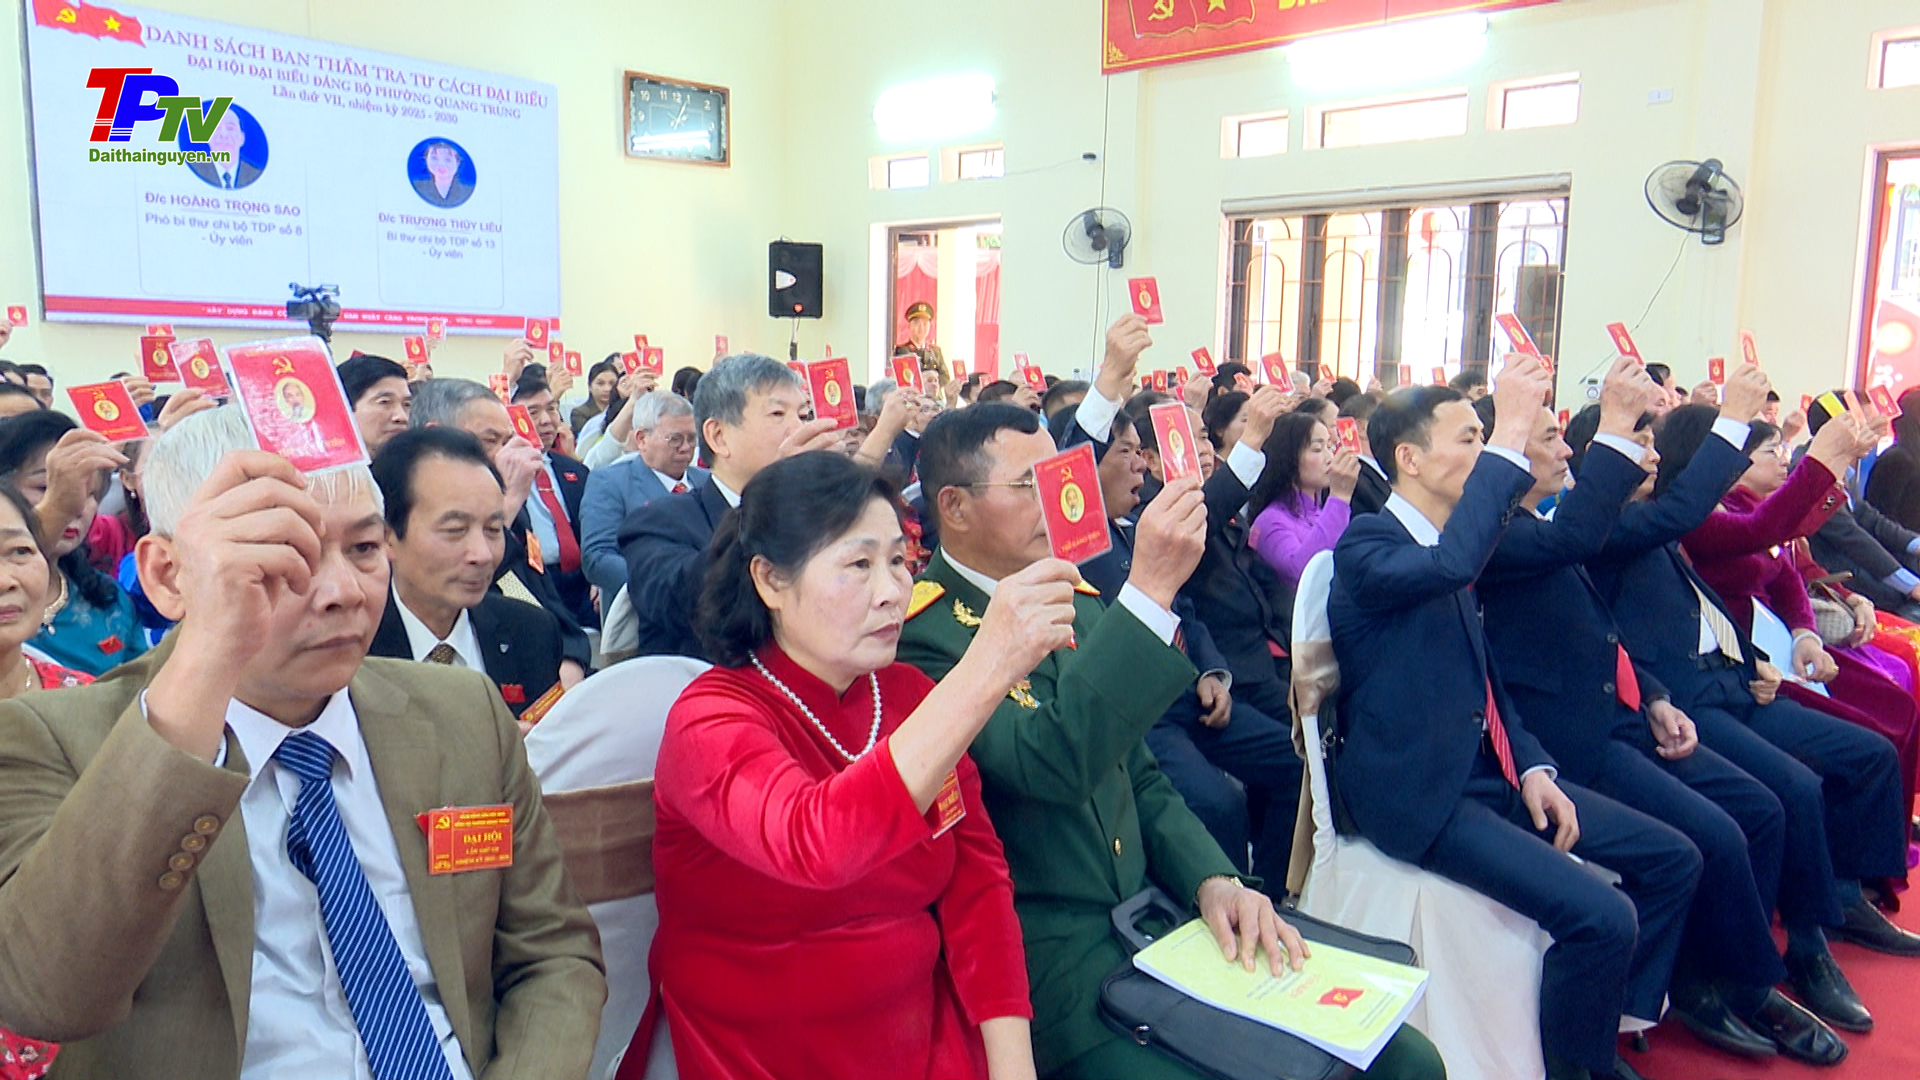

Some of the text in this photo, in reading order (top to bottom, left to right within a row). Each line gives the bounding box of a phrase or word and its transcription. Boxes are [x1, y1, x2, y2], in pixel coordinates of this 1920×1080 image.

[147, 25, 207, 49] DANH
[214, 37, 265, 59] SÁCH
[272, 48, 310, 67] BAN
[372, 64, 406, 85] TRA
[410, 72, 435, 88] TƯ
[439, 76, 482, 97] CÁCH
[486, 86, 511, 104] ĐẠI
[515, 90, 548, 109] BIỂU
[187, 54, 521, 120] ĐẠI HỘI ĐẠI BIỂU ĐẢNG BỘ PHƯỜNG QUANG TRUNG
[272, 84, 296, 100] Lần
[349, 98, 383, 114] nhiệm
[640, 90, 650, 102] 10
[660, 89, 667, 101] 11
[672, 92, 682, 103] 12
[704, 100, 711, 111] 2
[144, 192, 166, 205] Đ/c
[170, 194, 221, 209] HOÀNG
[225, 198, 271, 215] TRỌNG
